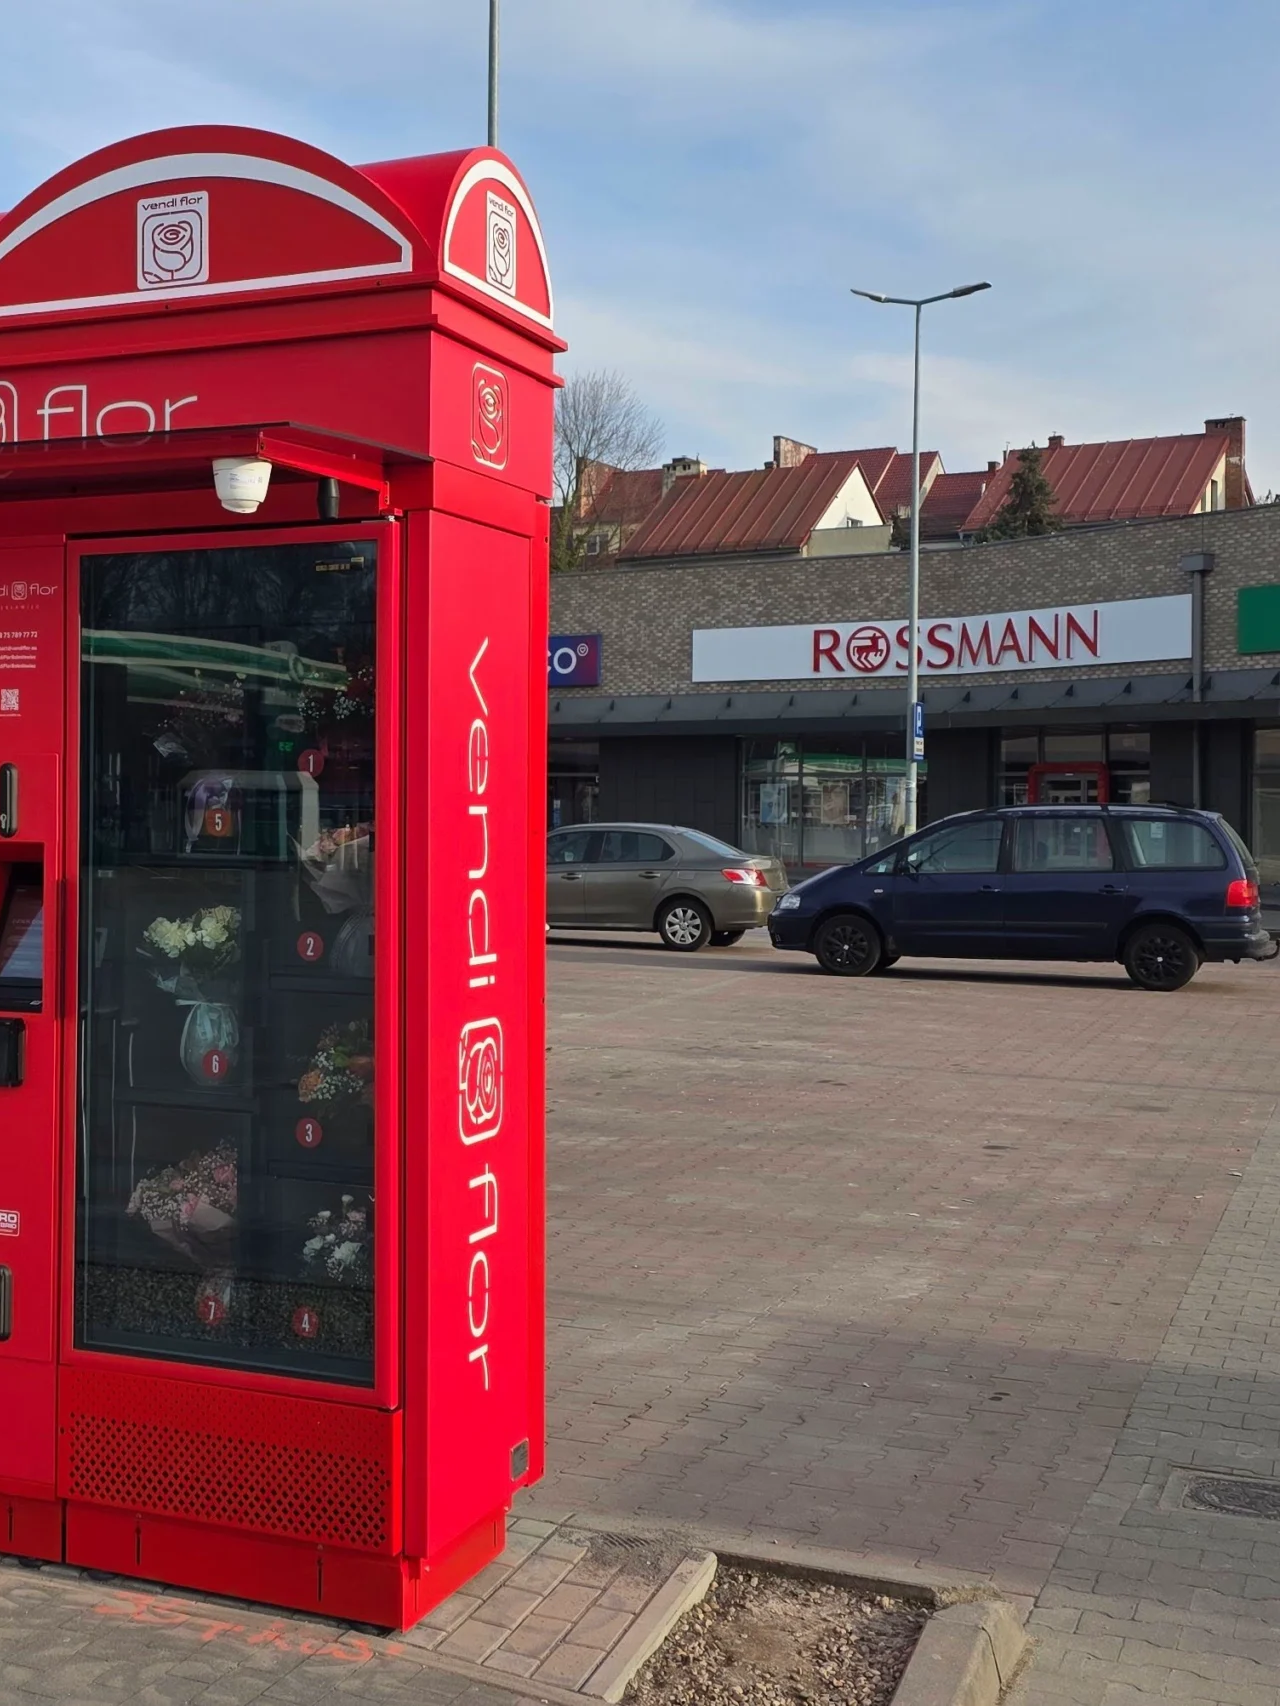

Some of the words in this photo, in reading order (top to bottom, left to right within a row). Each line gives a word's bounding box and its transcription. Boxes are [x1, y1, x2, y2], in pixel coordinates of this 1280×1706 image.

[141, 197, 177, 211] vendi
[180, 196, 203, 206] flor
[37, 384, 198, 447] flor
[29, 583, 58, 597] flor
[812, 609, 1101, 673] ROSSMANN
[548, 647, 577, 675] O
[307, 754, 315, 773] 1
[467, 636, 498, 989] vendi
[214, 813, 223, 832] 5
[306, 937, 315, 956] 2
[211, 1056, 220, 1075] 6
[305, 1124, 313, 1142] 3
[467, 1163, 499, 1391] flor
[207, 1302, 216, 1320] 7
[301, 1313, 310, 1332] 4
